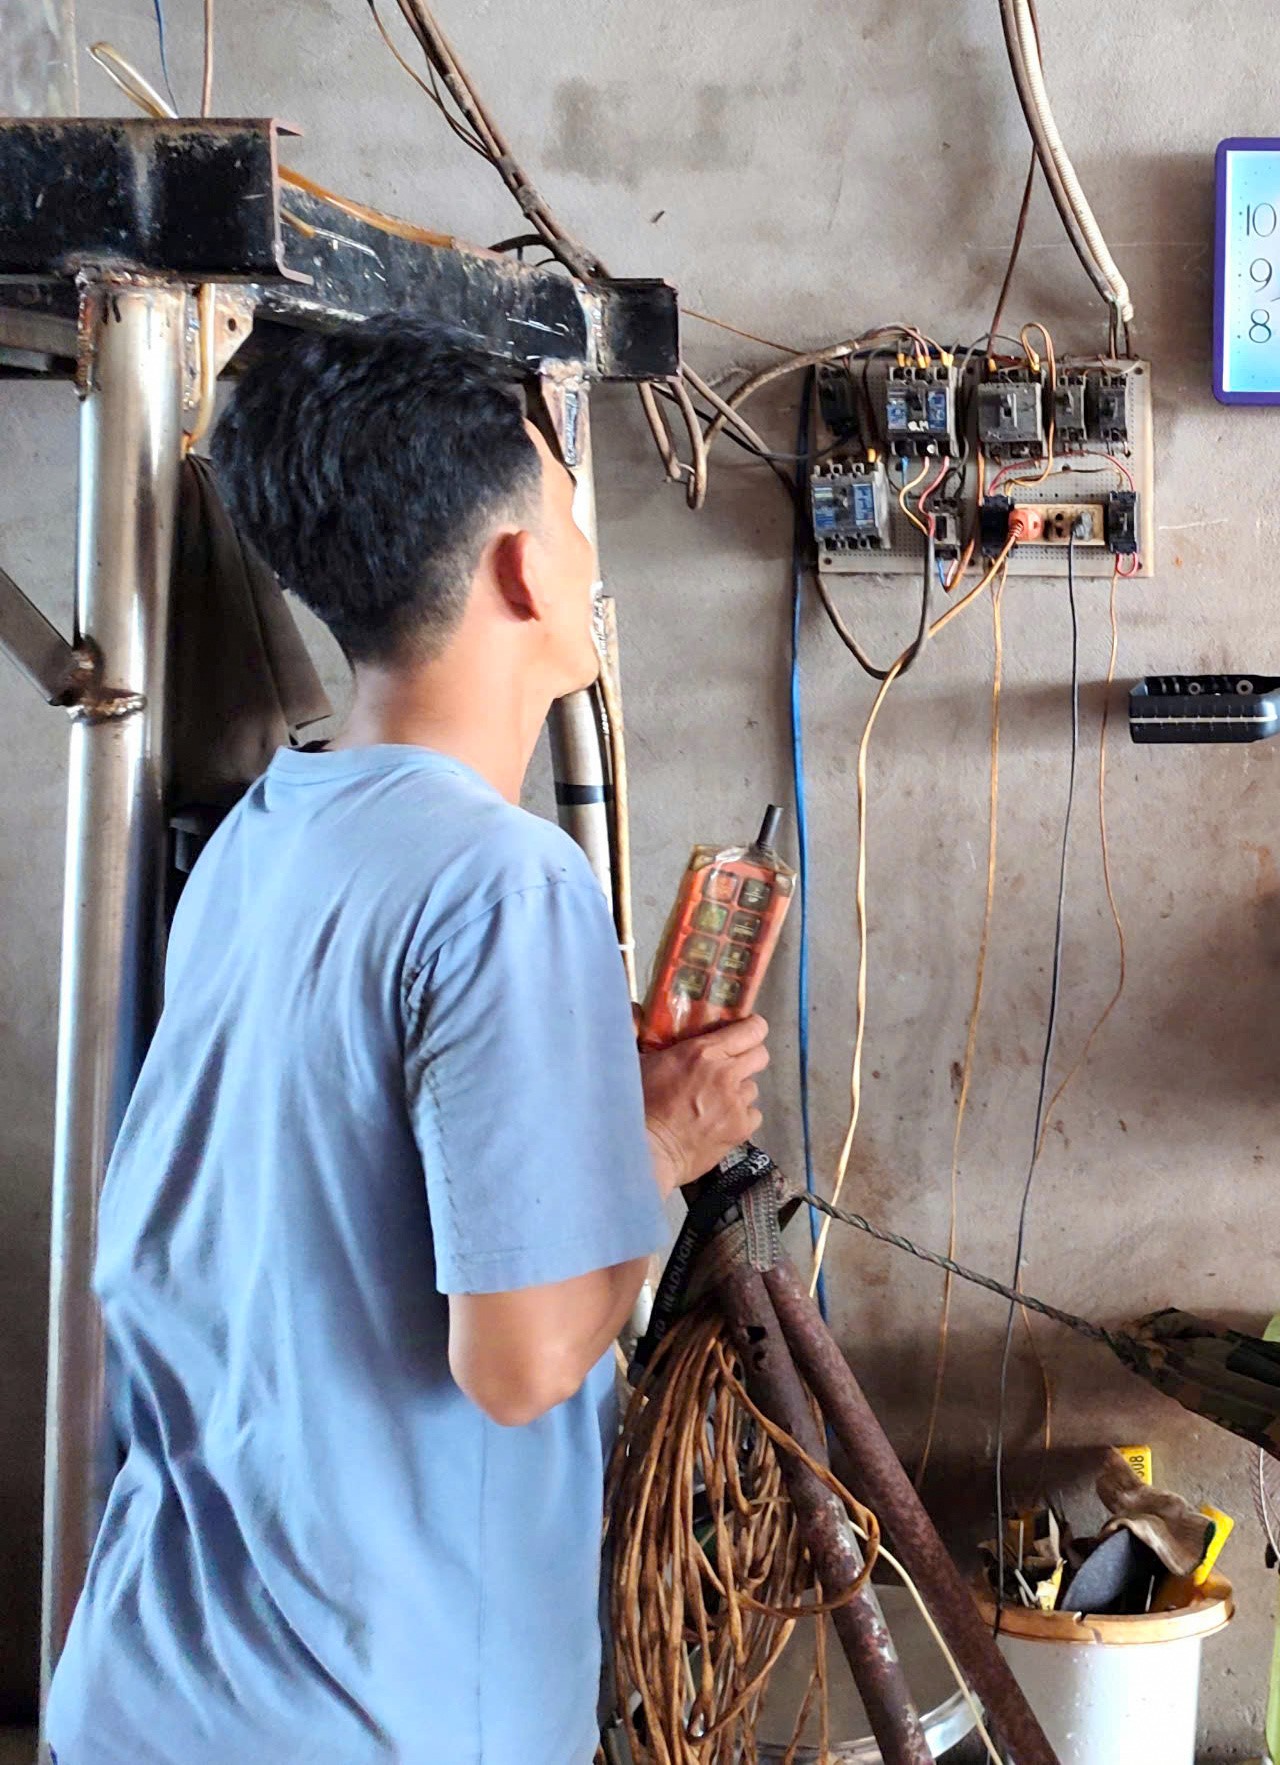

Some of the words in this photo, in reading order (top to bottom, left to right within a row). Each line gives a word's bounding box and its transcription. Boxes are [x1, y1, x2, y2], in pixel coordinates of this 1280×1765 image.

[1246, 202, 1277, 237] 10
[1249, 258, 1272, 293] 9
[1248, 308, 1271, 343] 8
